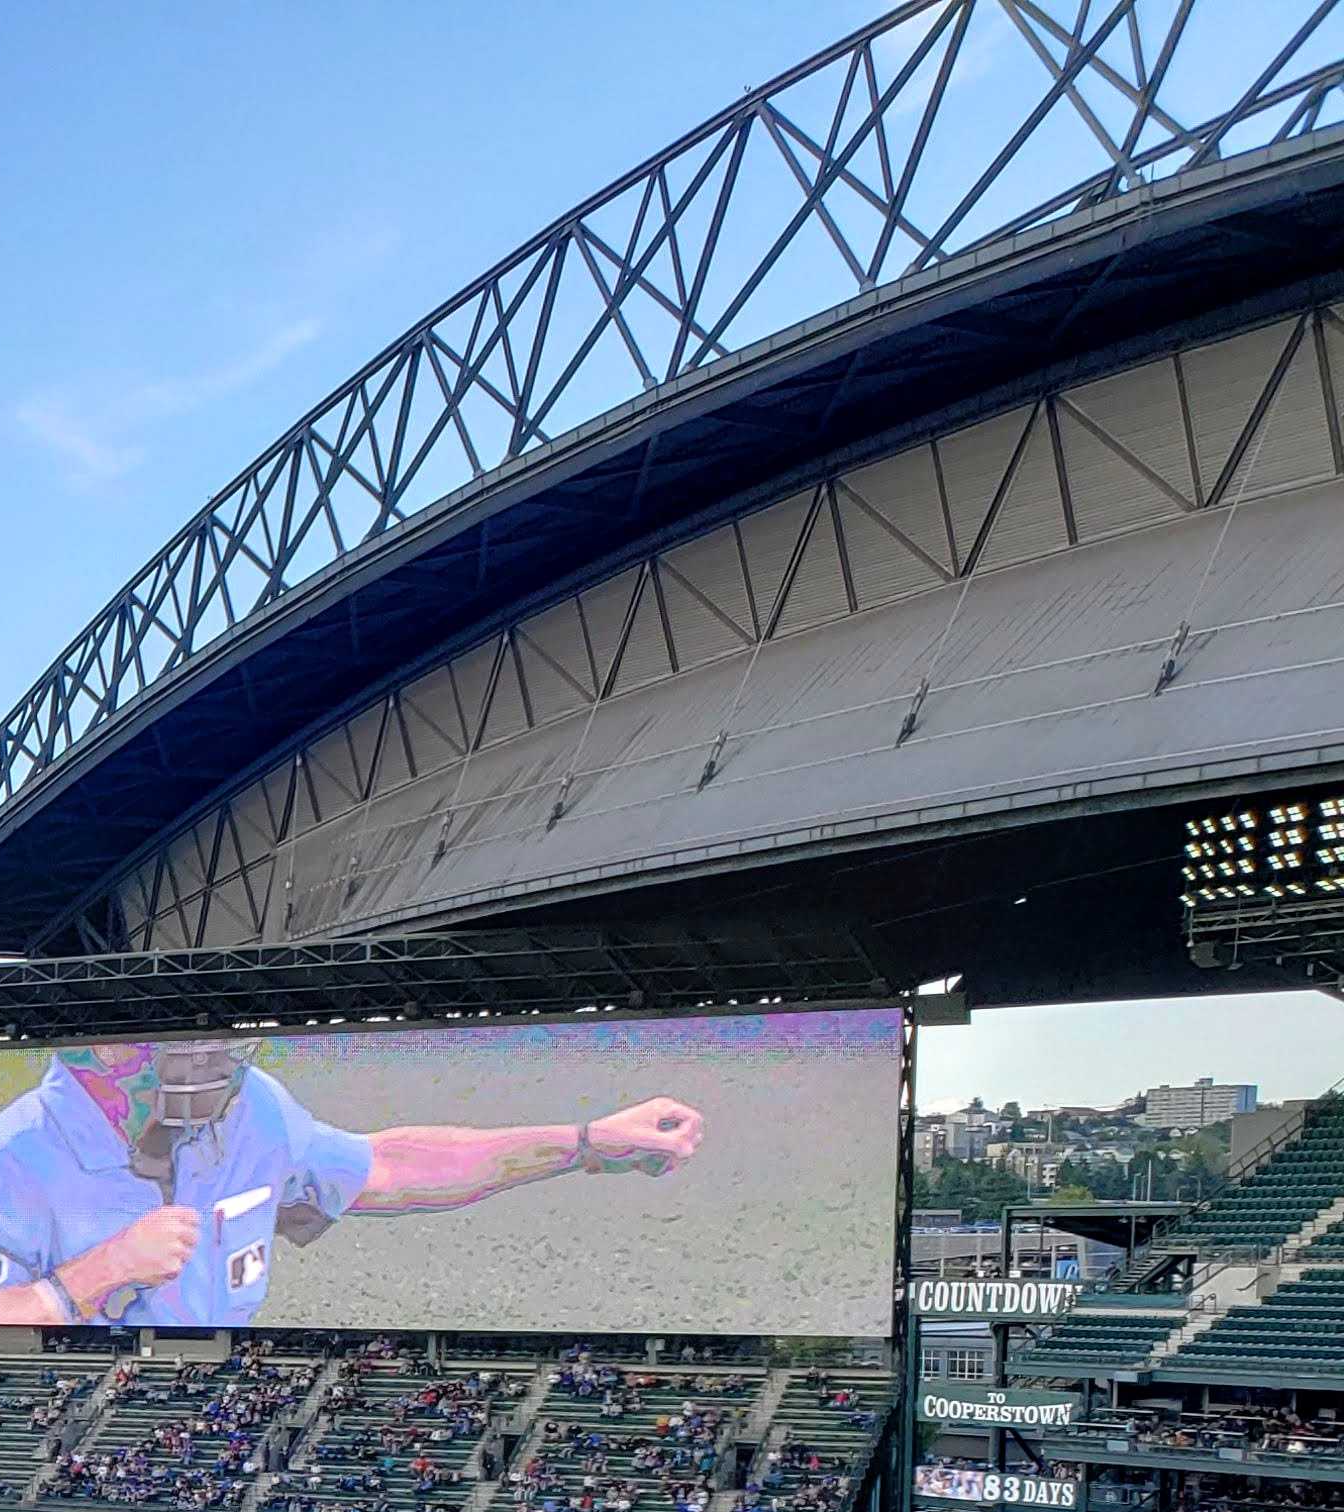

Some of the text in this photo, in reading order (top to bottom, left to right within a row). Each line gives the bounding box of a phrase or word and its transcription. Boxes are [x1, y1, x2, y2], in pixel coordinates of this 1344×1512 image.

[924, 1395, 1072, 1425] COOPERSTOWN
[987, 1392, 1006, 1404] TO
[1023, 1480, 1074, 1506] DAYS
